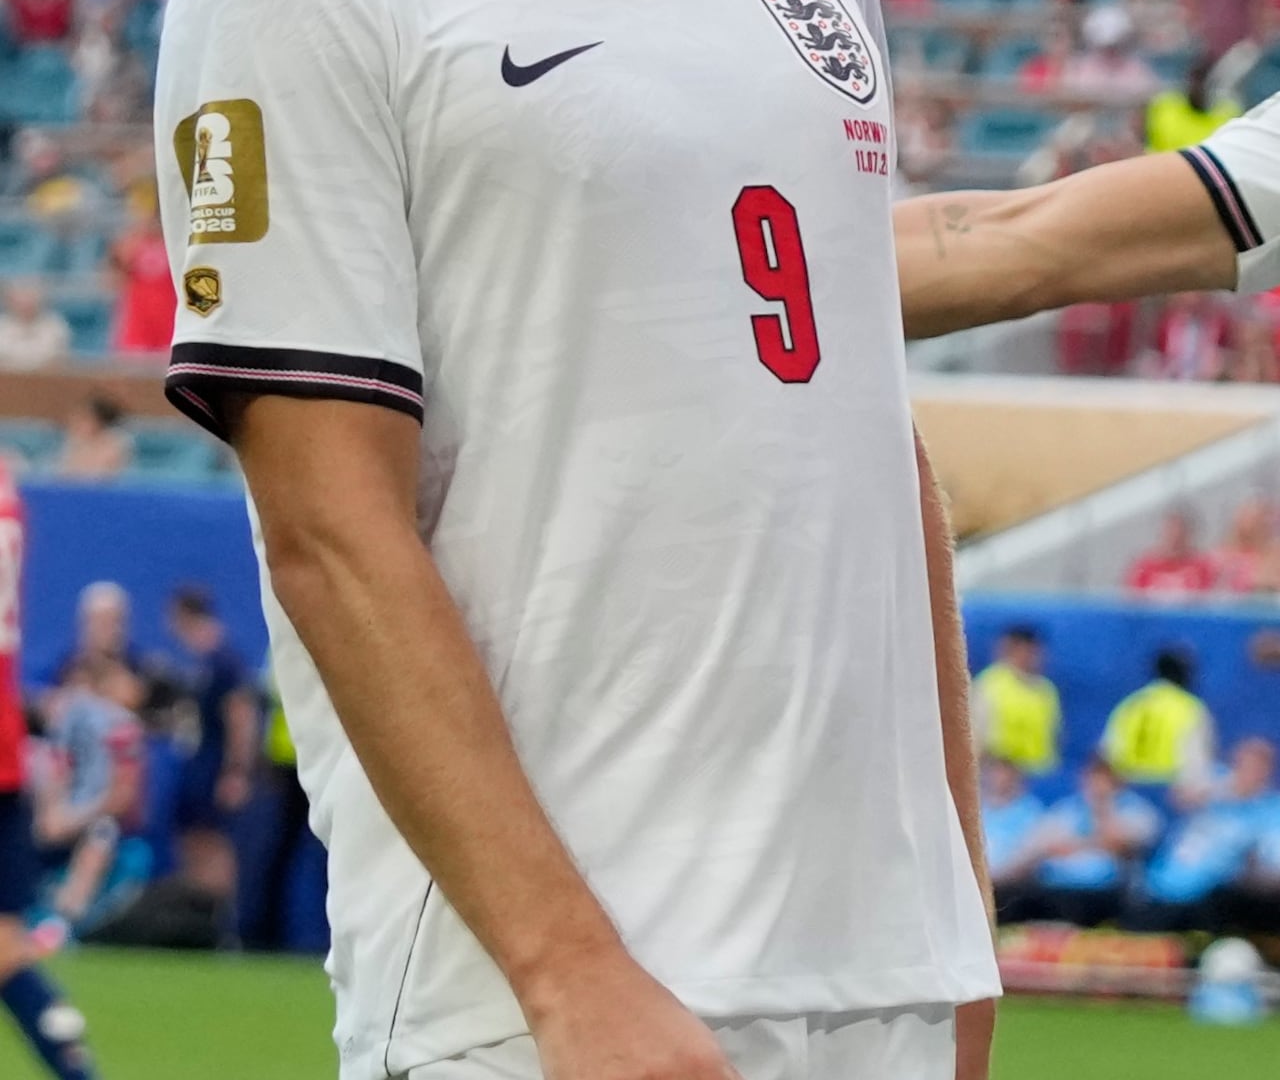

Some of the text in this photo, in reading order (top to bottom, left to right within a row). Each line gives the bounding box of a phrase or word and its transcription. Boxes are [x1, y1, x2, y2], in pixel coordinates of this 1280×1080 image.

[855, 150, 888, 176] 11.07.2
[214, 208, 236, 217] CUP
[191, 218, 236, 233] 026
[731, 185, 821, 383] 9
